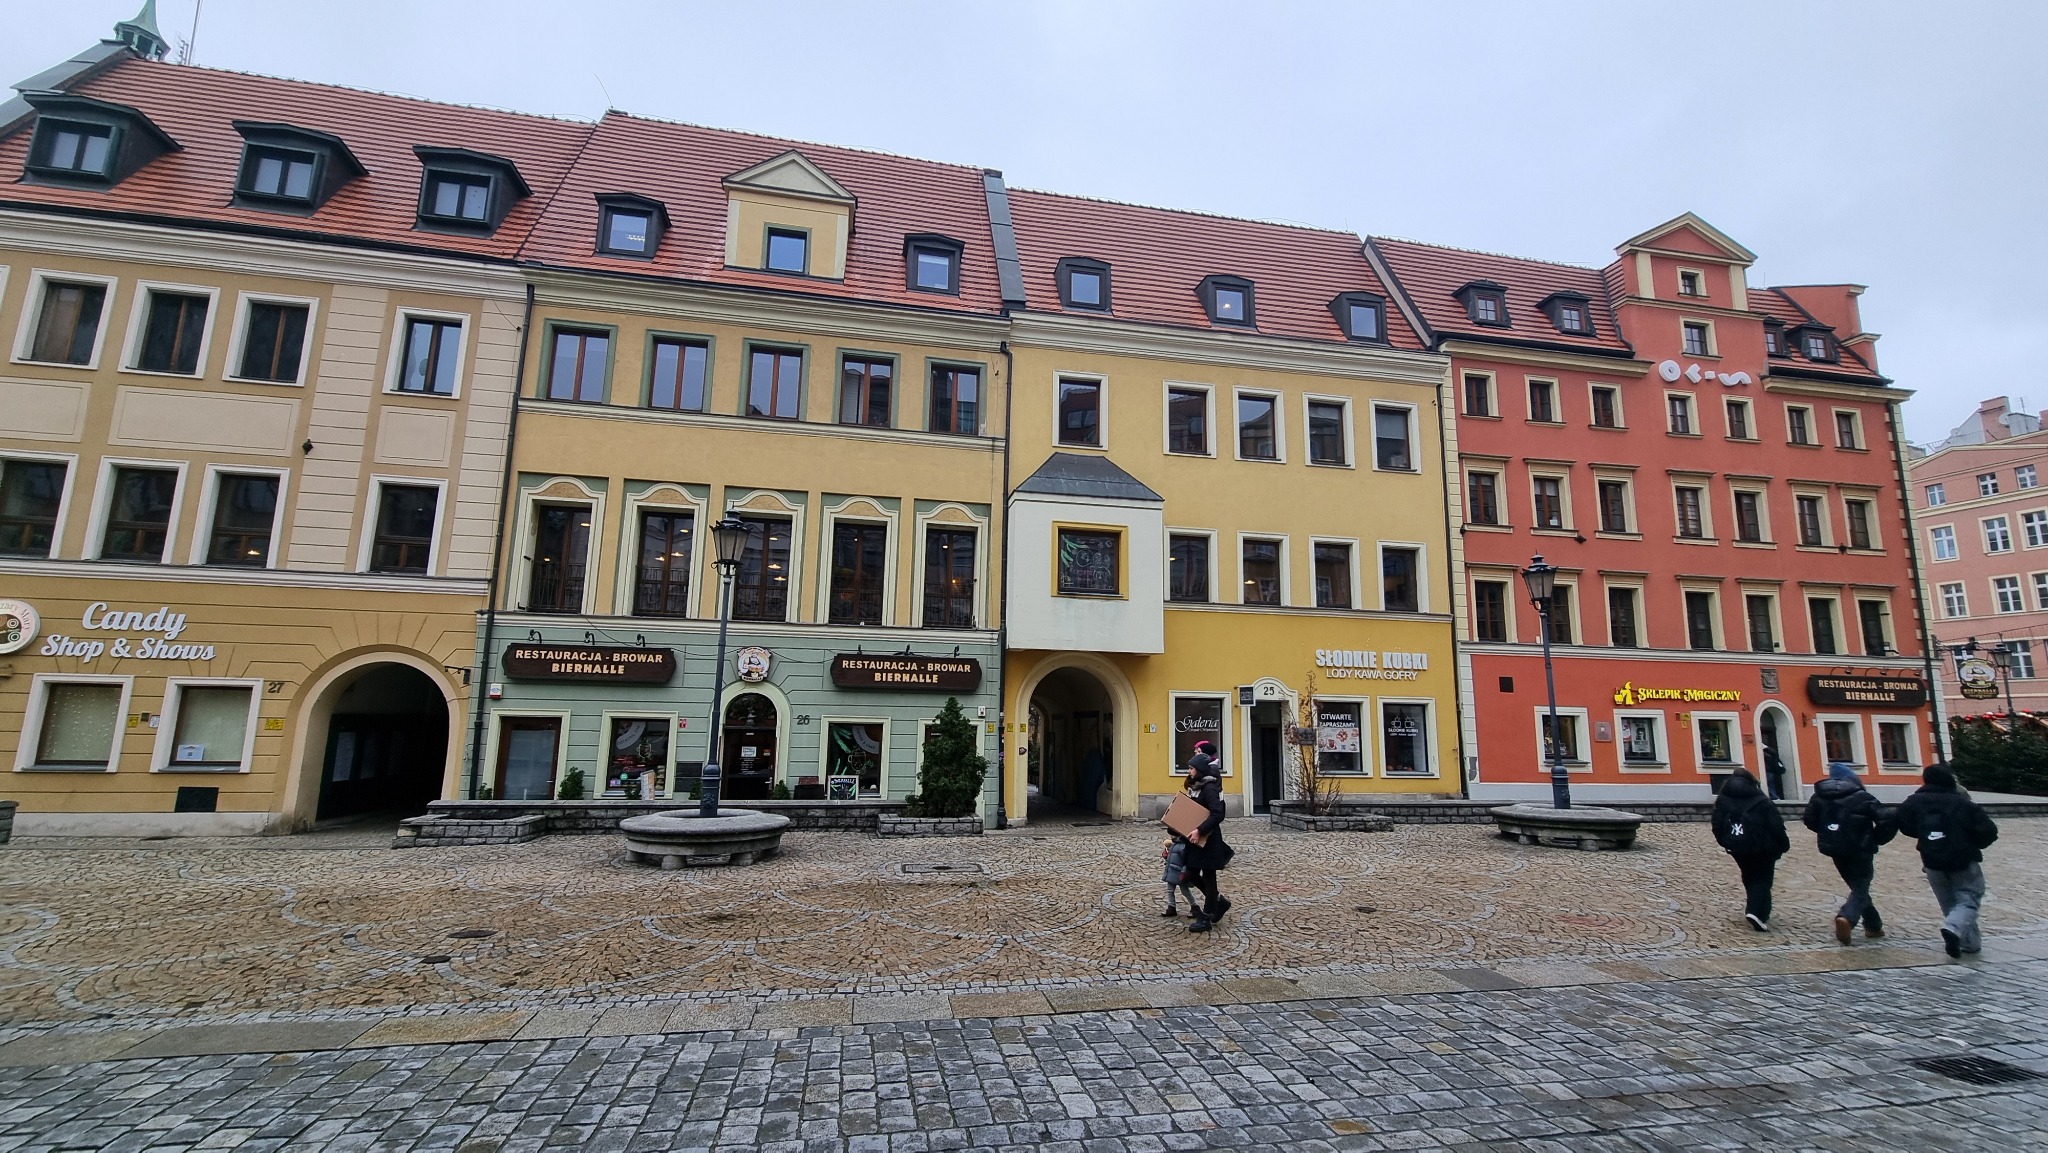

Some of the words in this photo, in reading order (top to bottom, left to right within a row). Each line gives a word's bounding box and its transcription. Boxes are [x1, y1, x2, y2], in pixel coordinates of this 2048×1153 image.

[82, 602, 187, 640] Candy
[41, 634, 105, 664] Shop
[110, 637, 132, 658] &
[136, 638, 216, 661] Shows
[515, 649, 602, 661] RESTAURACJA
[613, 653, 663, 663] BROWAR
[1315, 649, 1377, 668] SŁODKIE
[1382, 651, 1428, 670] KUBKI
[551, 663, 625, 675] BIERHALLE
[842, 660, 918, 671] RESTAURACJA
[927, 662, 971, 673] BROWAR
[874, 672, 938, 683] BIERHALLE
[1326, 668, 1354, 679] LODY
[1355, 669, 1383, 680] KAWA
[1384, 670, 1418, 681] GOFRY
[268, 682, 285, 694] 27
[1263, 686, 1275, 696] 25
[1818, 679, 1877, 691] RESTAURACJA
[1883, 681, 1918, 691] BROWAR
[1845, 691, 1896, 702] BIERHALLE
[1741, 703, 1750, 711] 24
[796, 714, 810, 726] 26
[1320, 713, 1352, 721] OTWARTE
[1175, 715, 1220, 732] Galeria
